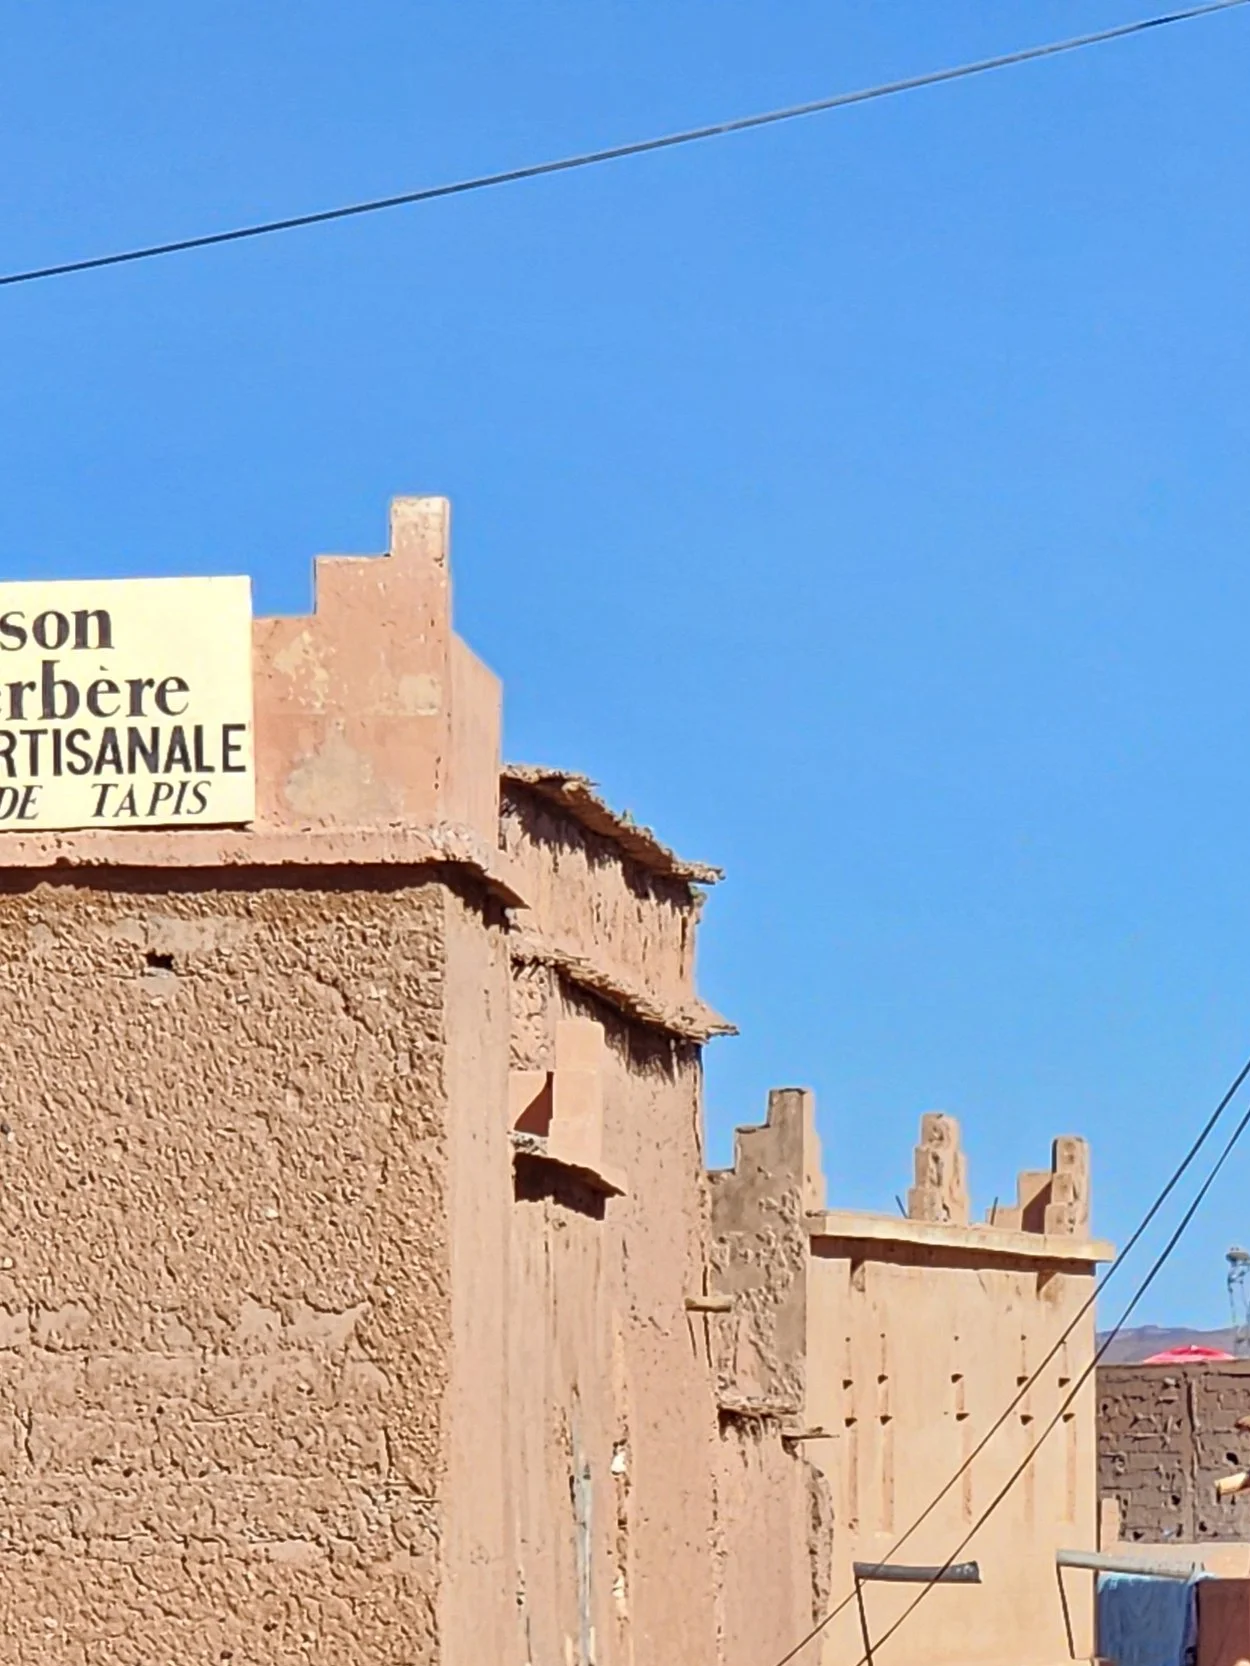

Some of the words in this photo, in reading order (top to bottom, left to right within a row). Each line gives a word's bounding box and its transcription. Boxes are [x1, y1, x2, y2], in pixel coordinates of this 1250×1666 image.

[0, 609, 114, 651] son
[0, 659, 190, 721] rbère
[0, 784, 43, 820] DE
[91, 780, 212, 818] TAPIS
